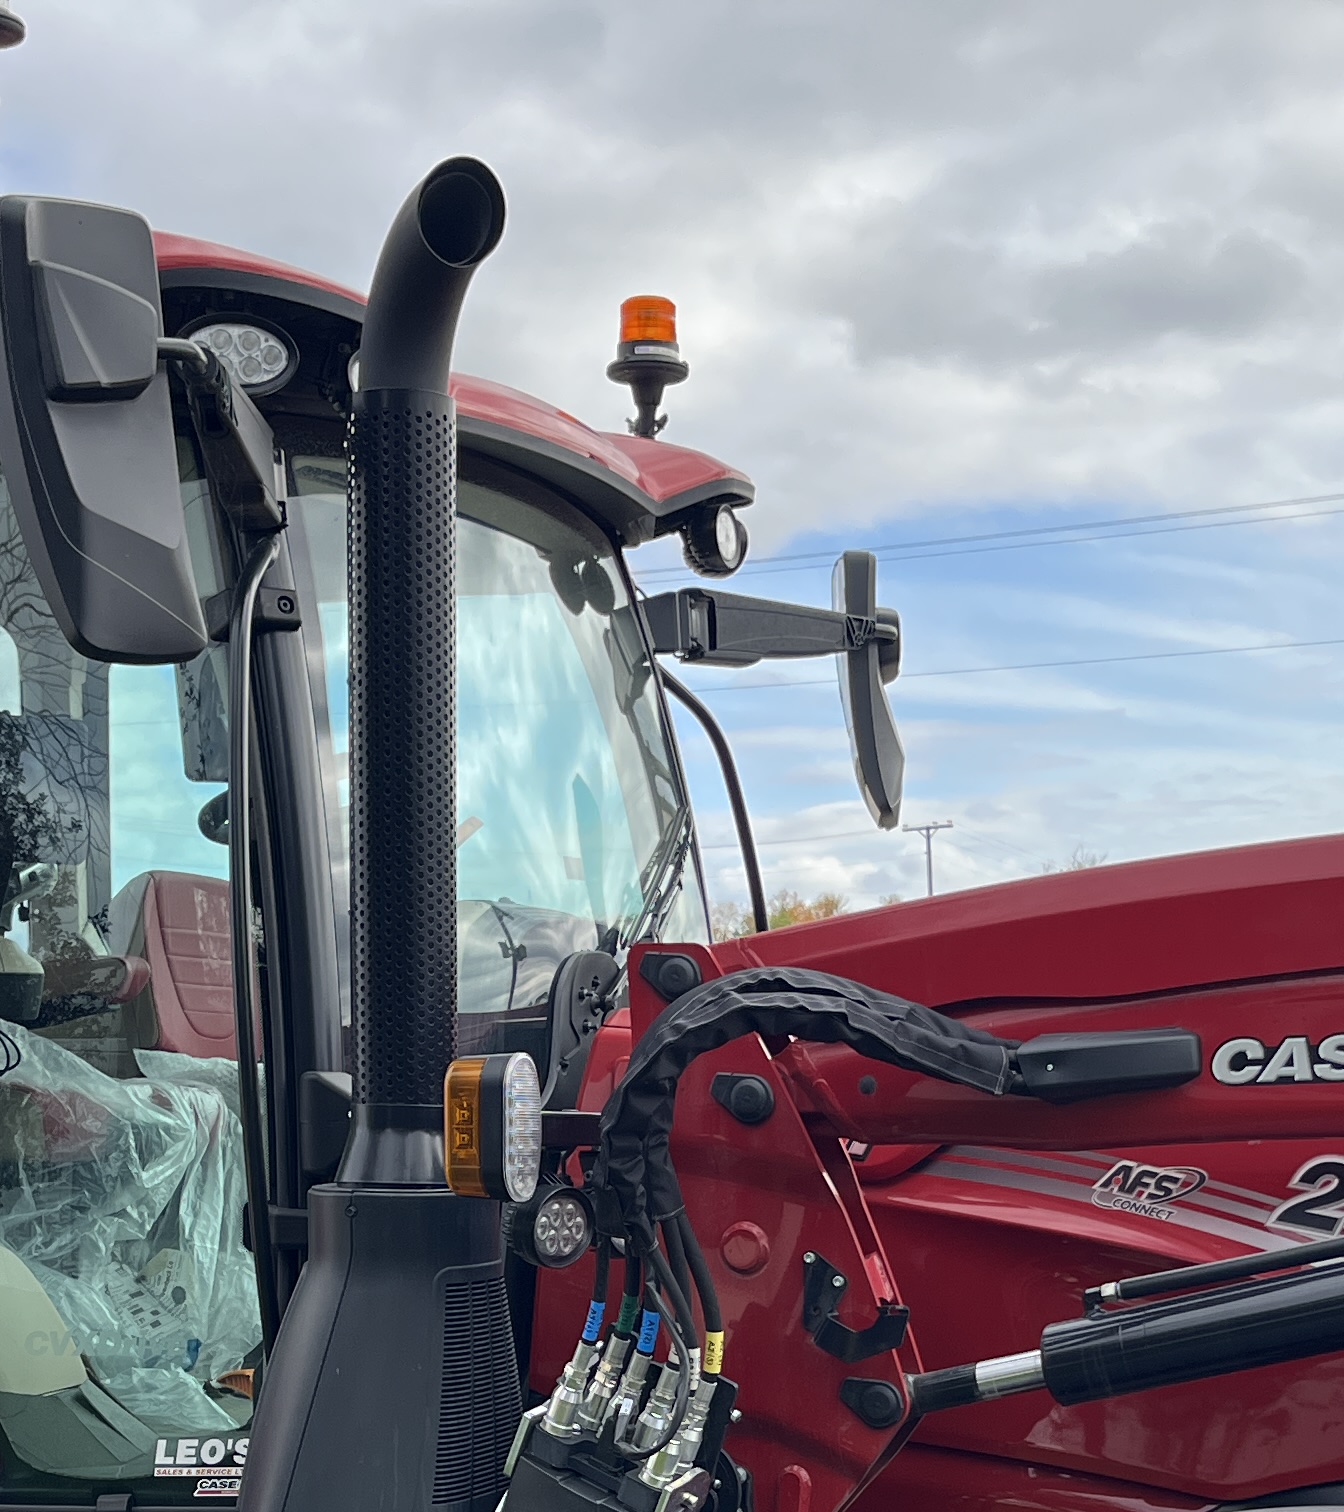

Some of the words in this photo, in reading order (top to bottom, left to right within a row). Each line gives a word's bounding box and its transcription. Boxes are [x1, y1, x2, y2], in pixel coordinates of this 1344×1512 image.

[1094, 1161, 1187, 1202] AFS
[1112, 1198, 1175, 1221] CONNECT
[154, 1438, 250, 1466] LEO'S
[156, 1468, 184, 1476] SALES
[186, 1468, 193, 1476] &
[196, 1468, 233, 1476] SERVICE
[199, 1480, 238, 1489] CASE
